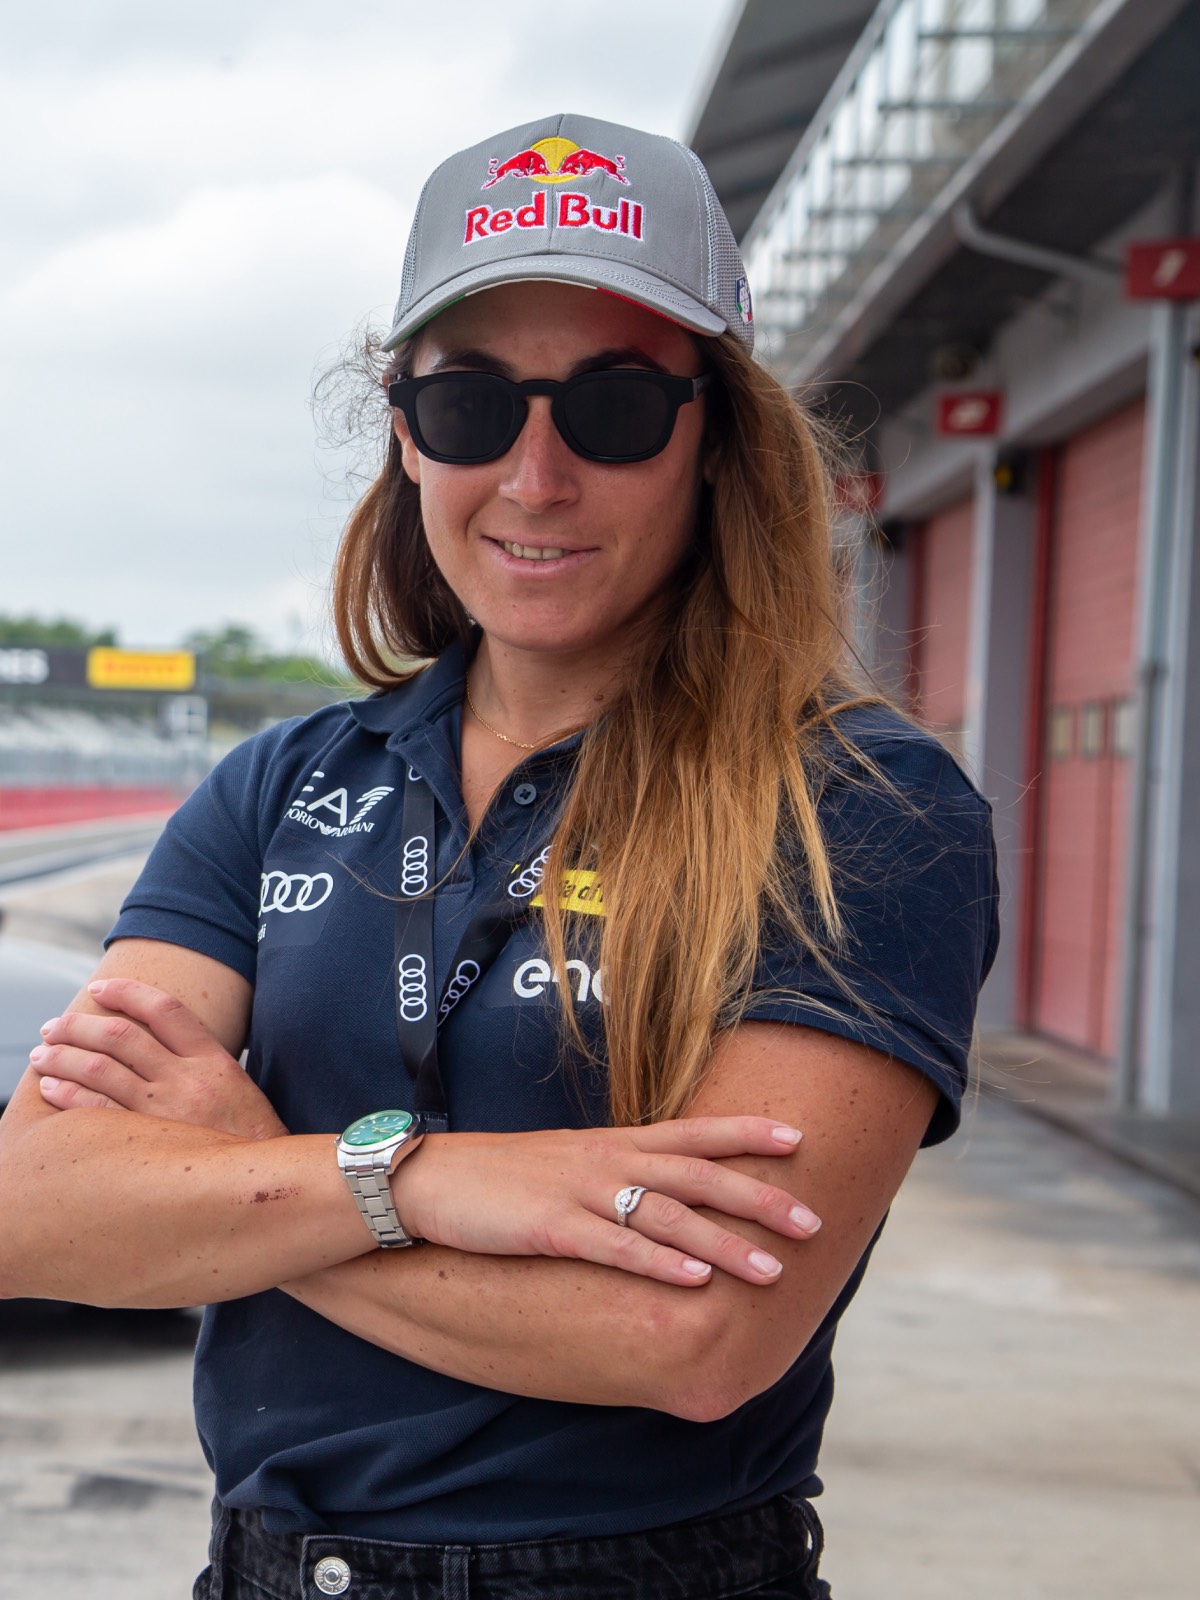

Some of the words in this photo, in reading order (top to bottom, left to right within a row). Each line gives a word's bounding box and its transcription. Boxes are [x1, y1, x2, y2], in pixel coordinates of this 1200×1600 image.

[463, 190, 546, 245] Red
[556, 192, 643, 241] Bull
[331, 821, 375, 837] ARMANI
